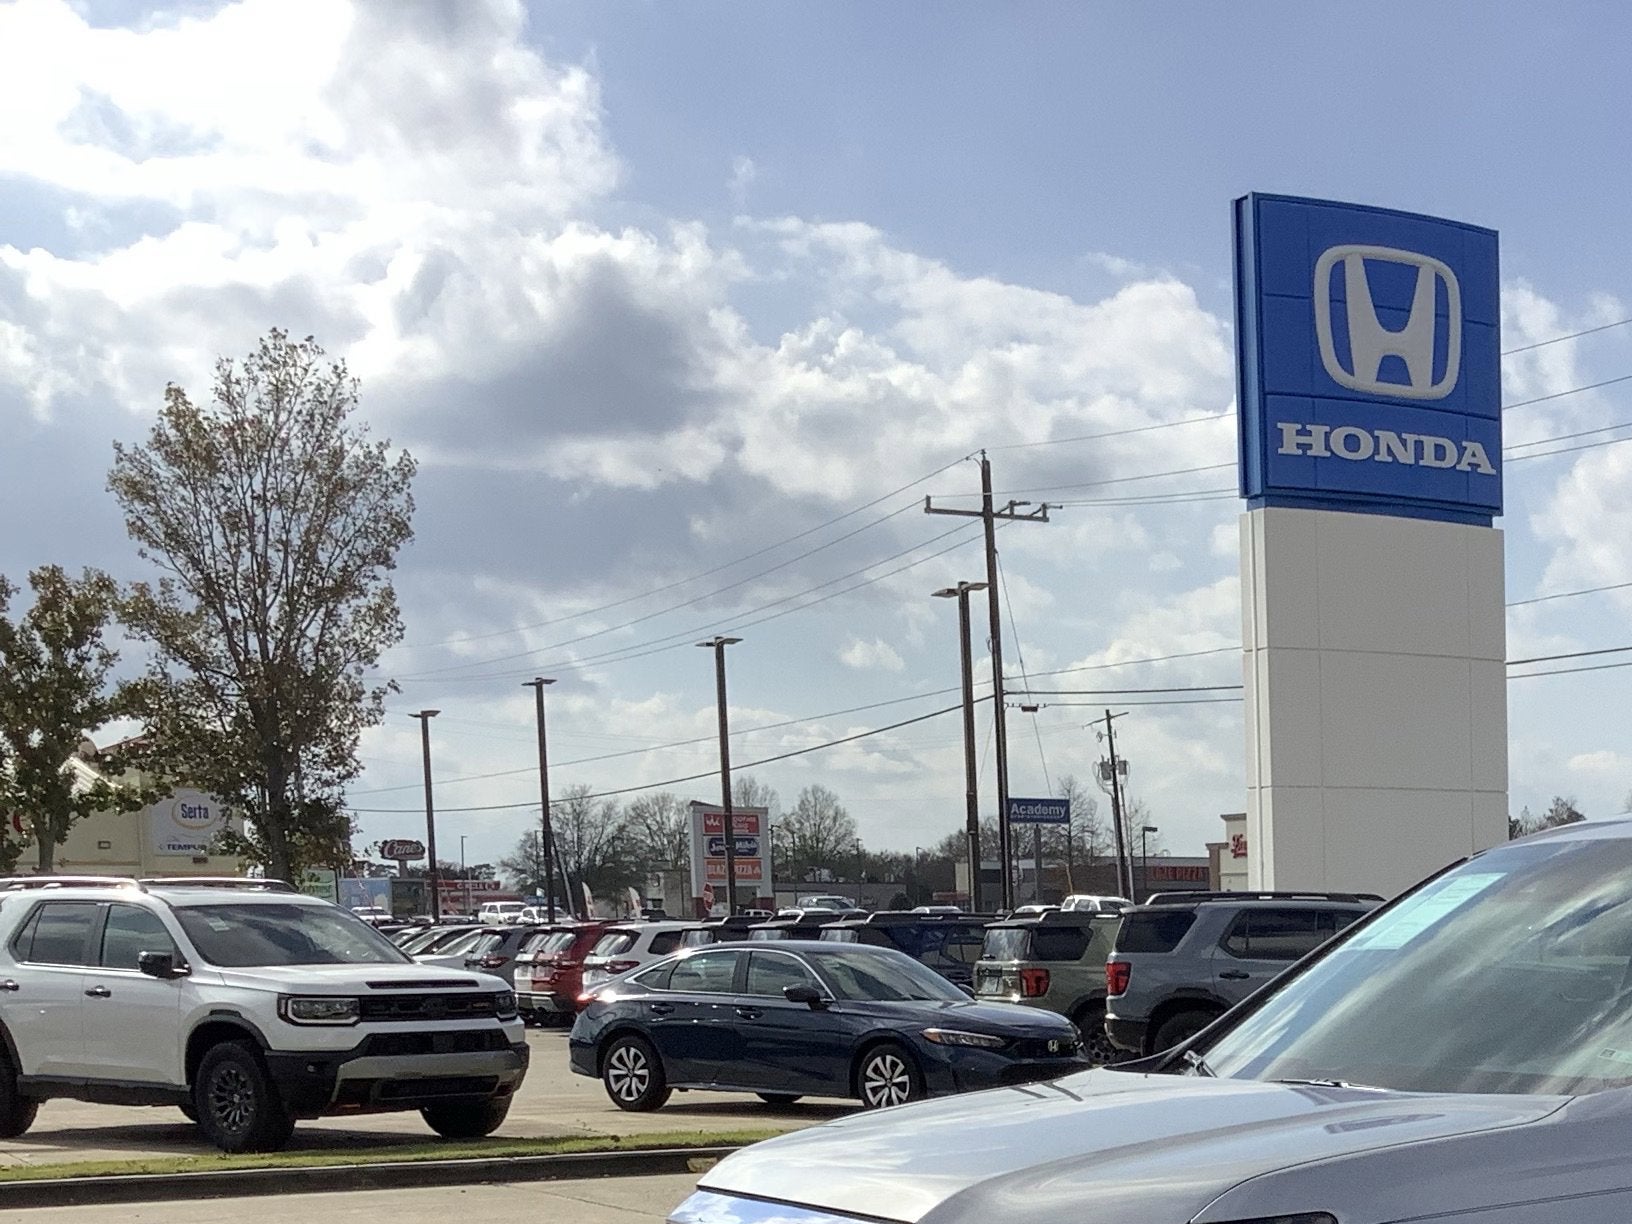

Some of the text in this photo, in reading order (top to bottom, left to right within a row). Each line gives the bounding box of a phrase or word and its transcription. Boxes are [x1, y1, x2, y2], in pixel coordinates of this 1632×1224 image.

[1277, 421, 1497, 475] HONDA
[180, 803, 209, 820] Serta
[1010, 803, 1067, 818] Academy
